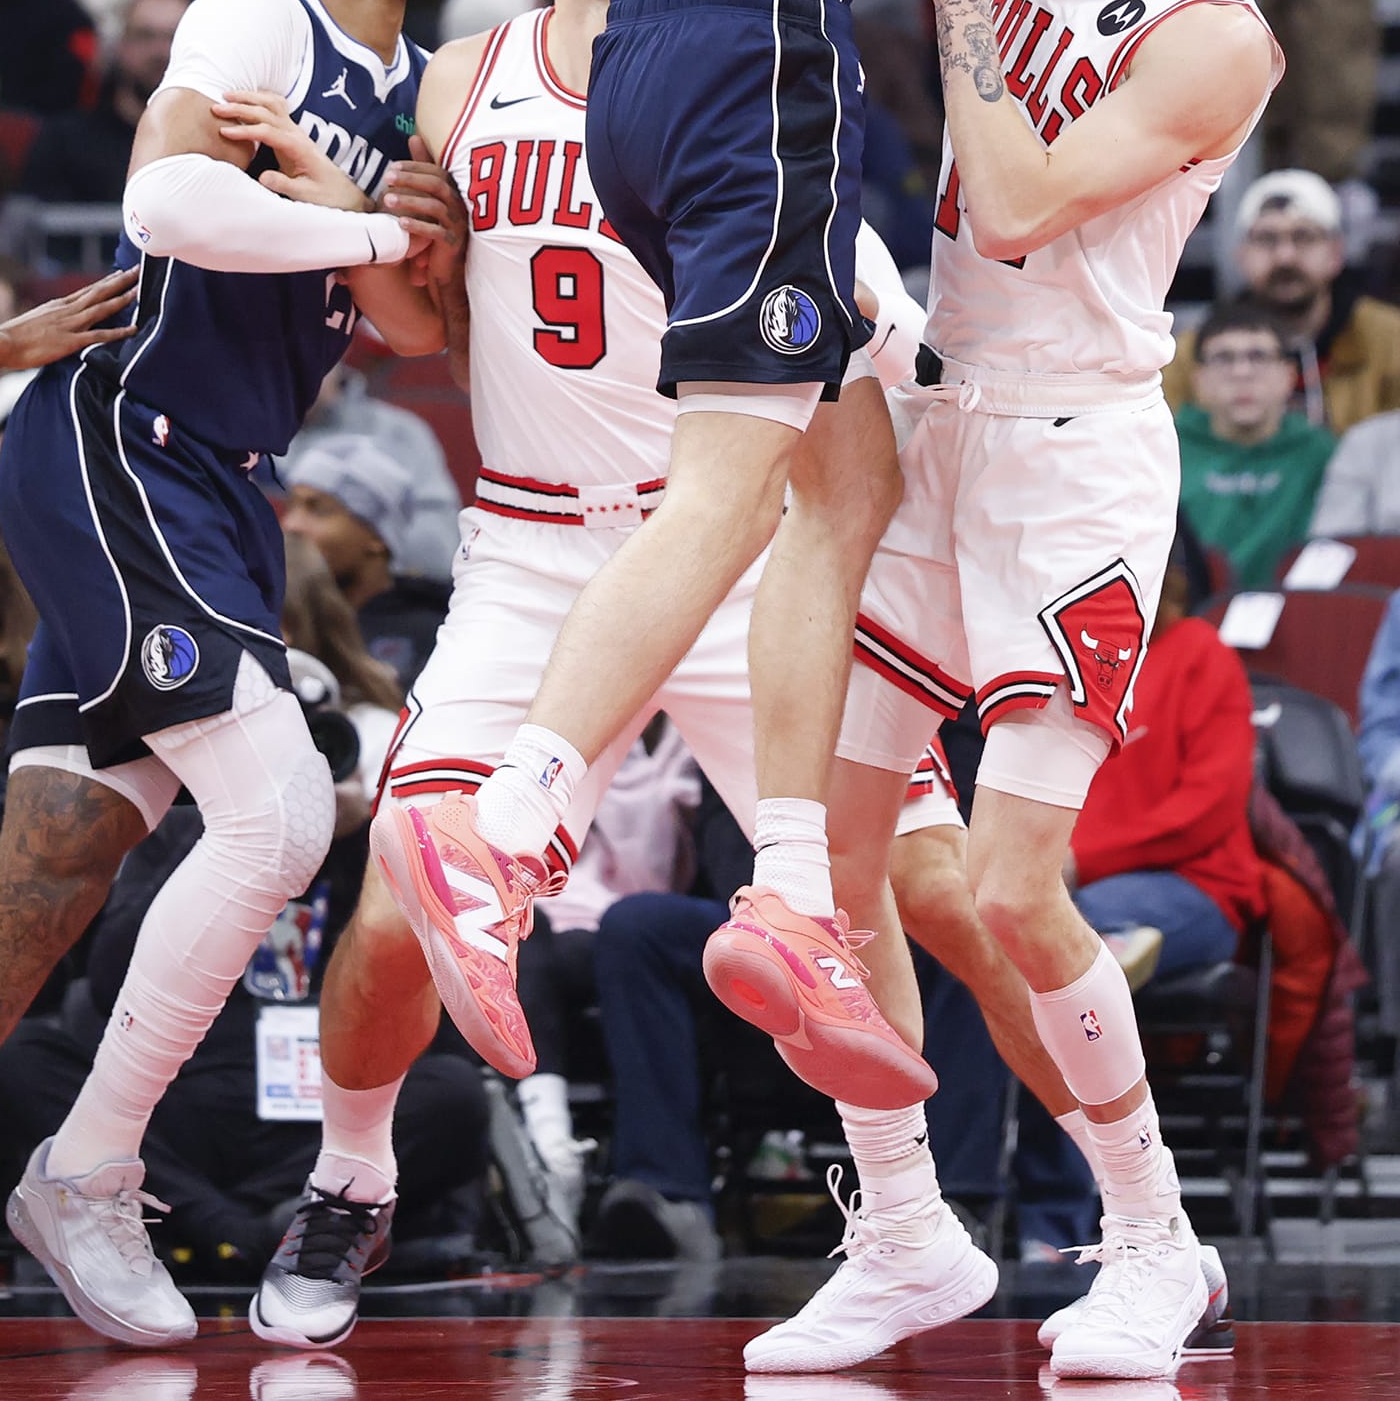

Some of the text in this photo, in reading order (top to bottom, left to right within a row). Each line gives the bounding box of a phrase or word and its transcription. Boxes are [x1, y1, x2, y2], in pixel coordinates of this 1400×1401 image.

[395, 112, 417, 135] chi
[468, 140, 624, 242] BUL
[530, 245, 607, 370] 9
